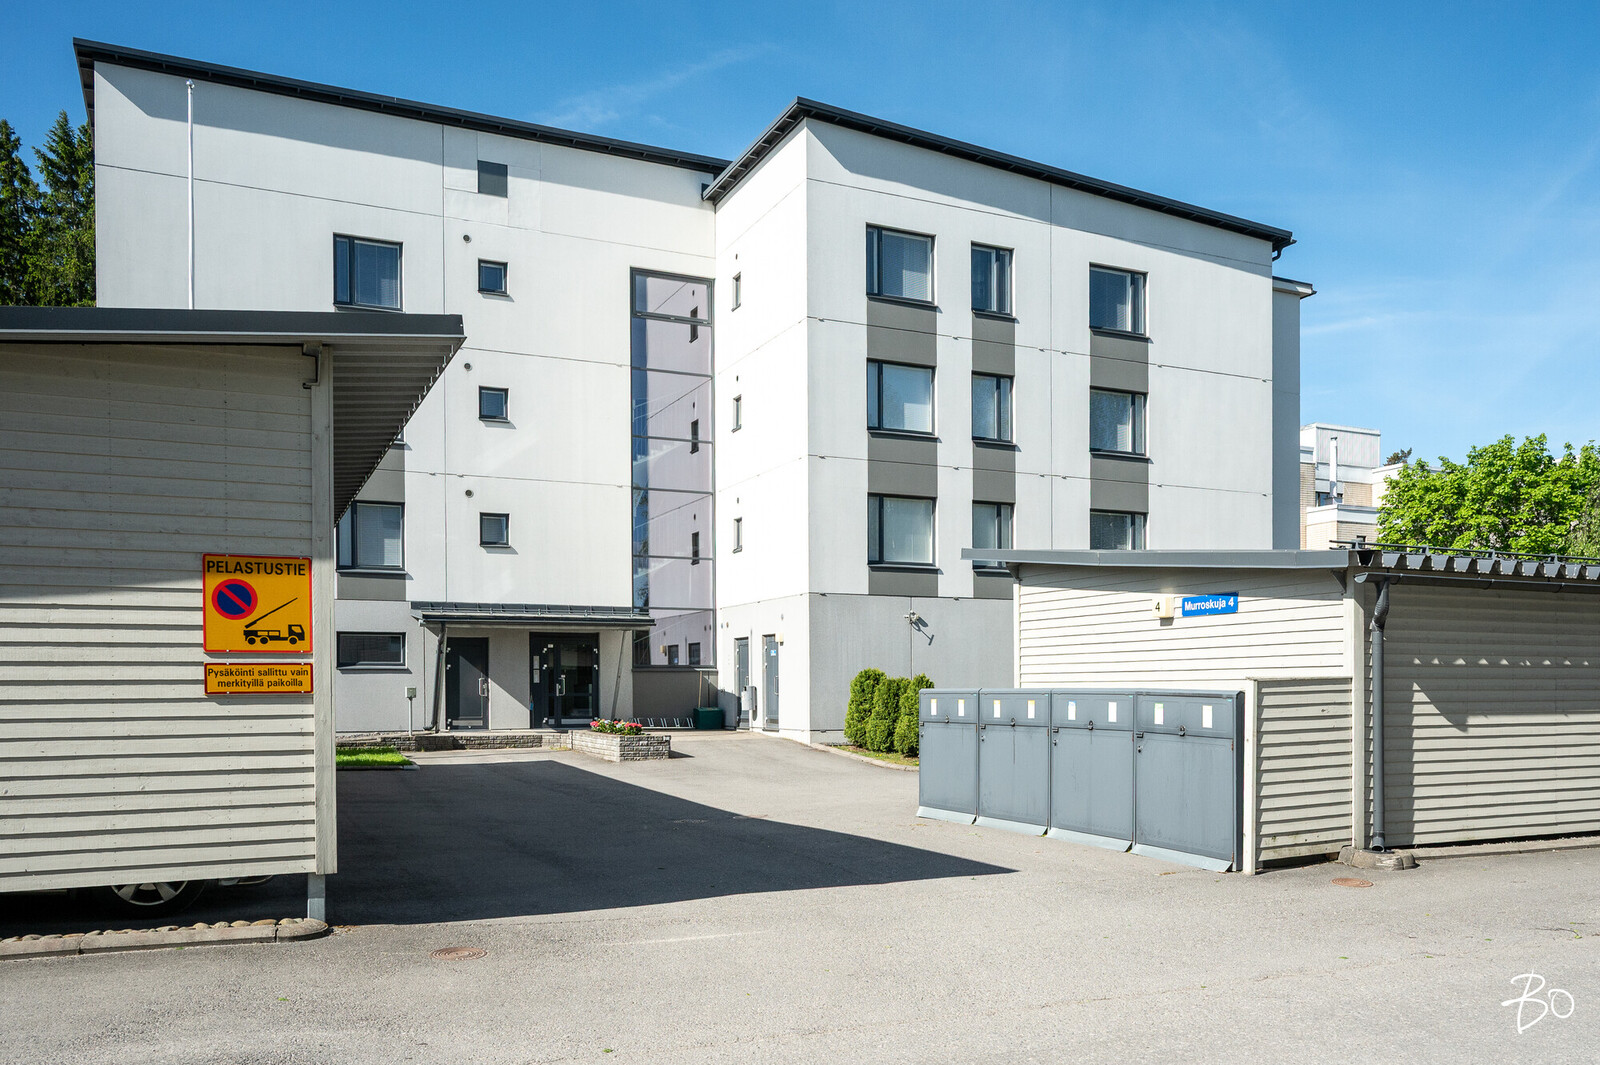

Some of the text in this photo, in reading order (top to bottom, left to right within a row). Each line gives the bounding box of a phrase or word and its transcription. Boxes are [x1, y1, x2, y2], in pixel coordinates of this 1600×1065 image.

[207, 560, 306, 576] PELASTUSTIE
[1155, 602, 1160, 612] 4
[1184, 597, 1234, 611] Murroskuja 4
[207, 668, 309, 678] Pysäköinti sallittu vain
[217, 678, 303, 688] merkityillä paikoilla
